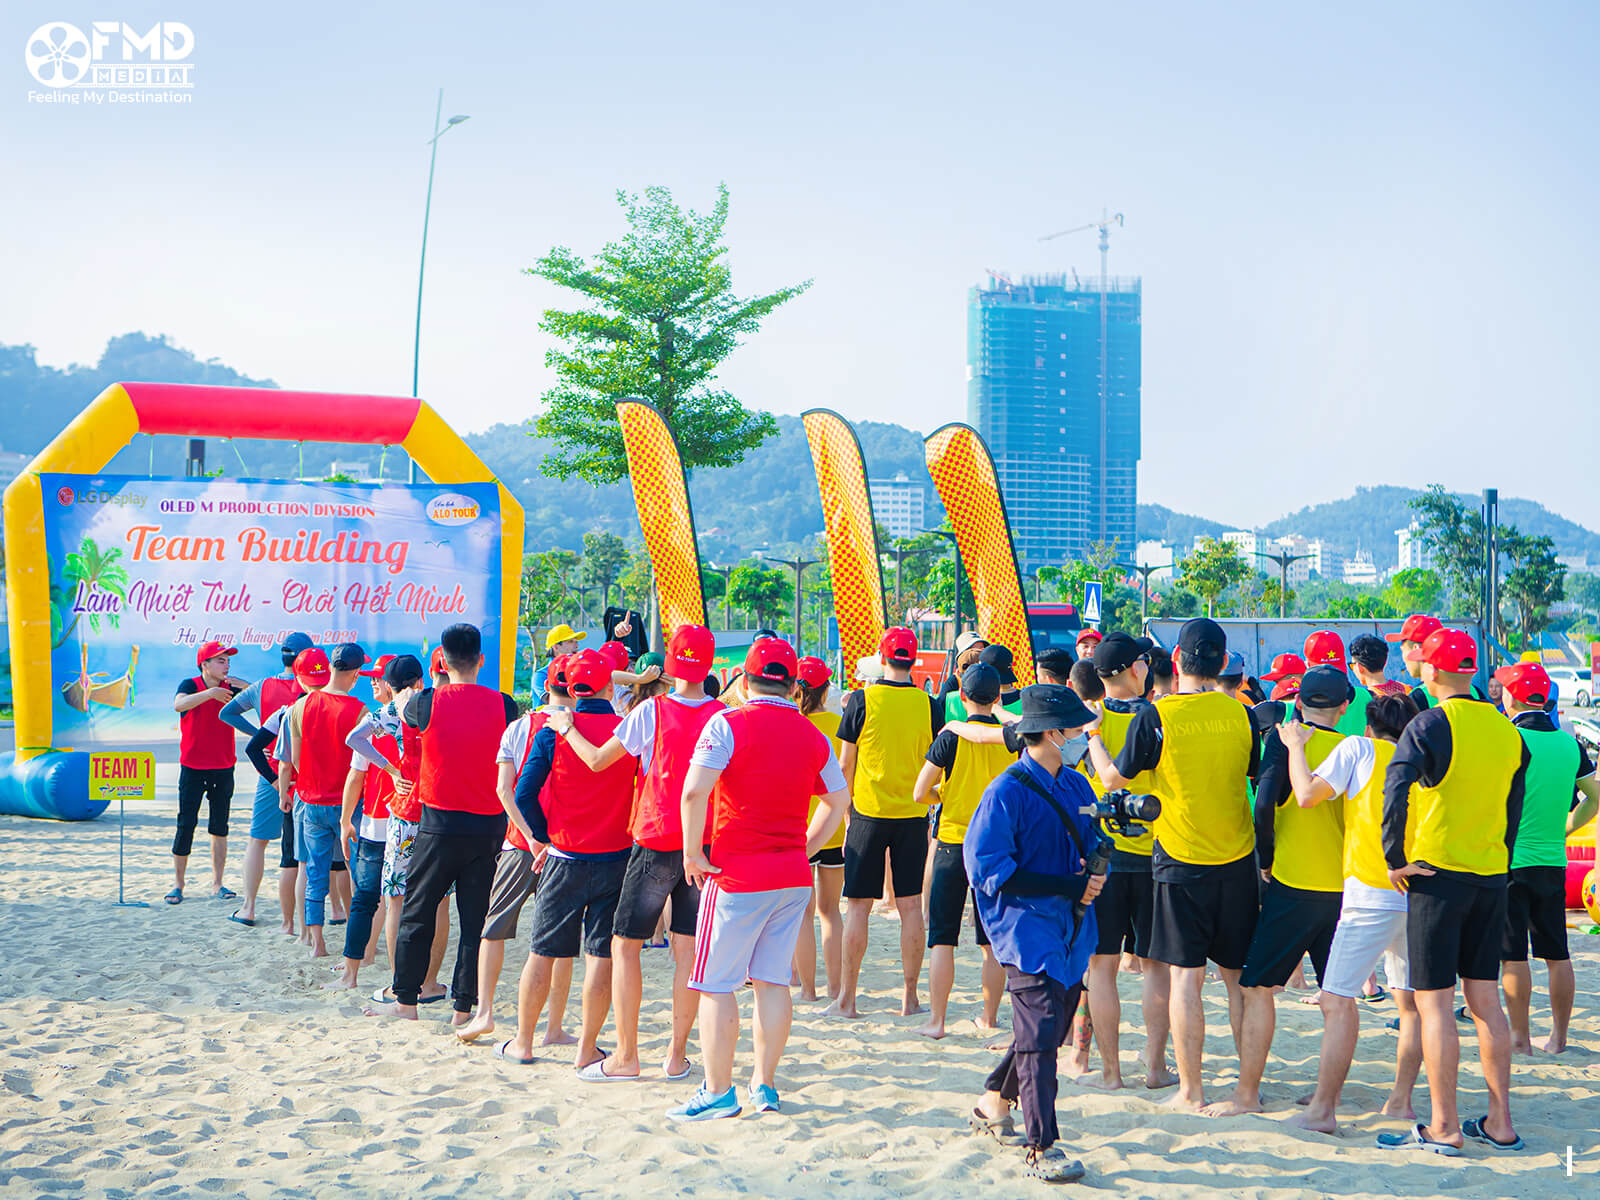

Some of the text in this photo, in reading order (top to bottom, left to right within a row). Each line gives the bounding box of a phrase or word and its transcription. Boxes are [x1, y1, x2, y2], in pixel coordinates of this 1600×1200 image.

[77, 490, 149, 510] LG Display
[160, 500, 375, 517] OLED M PRODUCTION DIVISION
[432, 508, 478, 520] ALO TOUR
[126, 525, 409, 575] Team Building
[73, 581, 122, 613] Làm
[128, 580, 195, 622] Nhiệt
[201, 580, 252, 613] Tình
[282, 579, 338, 614] Chơi
[344, 580, 393, 615] Hết
[396, 581, 467, 624] Mình
[92, 757, 151, 779] TEAM 1
